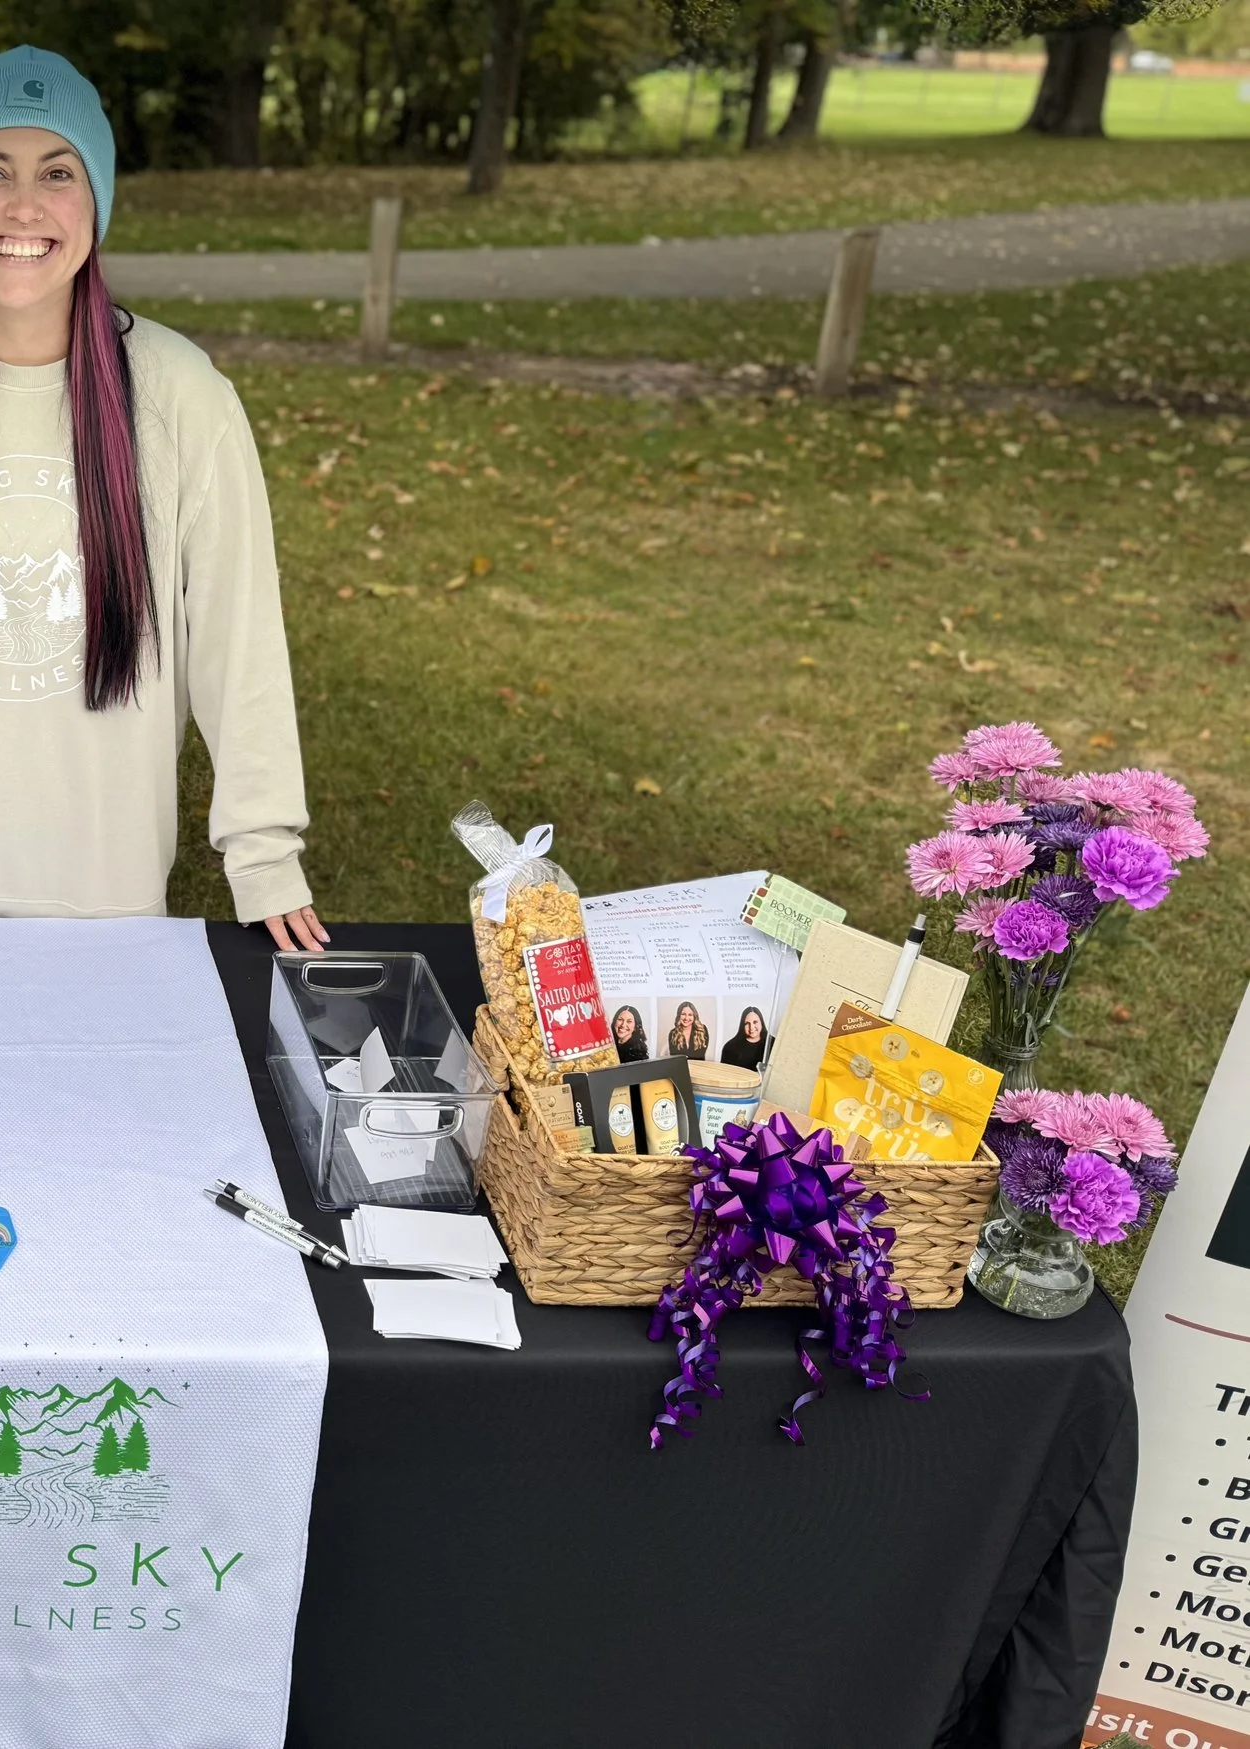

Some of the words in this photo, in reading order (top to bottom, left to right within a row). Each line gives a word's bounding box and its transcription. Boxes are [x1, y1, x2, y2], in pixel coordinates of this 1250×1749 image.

[35, 469, 75, 494] SK
[669, 888, 708, 896] SKY
[607, 908, 656, 916] Immediate
[658, 904, 702, 912] Openings
[538, 988, 570, 1008] SALTED
[572, 982, 598, 999] CARAM
[842, 1021, 872, 1030] Chocolate
[576, 1102, 584, 1124] GOAT
[240, 1191, 274, 1213] WELLNESS
[62, 1542, 244, 1592] SKY
[1144, 1661, 1250, 1707] Disor
[1086, 1706, 1154, 1741] isit
